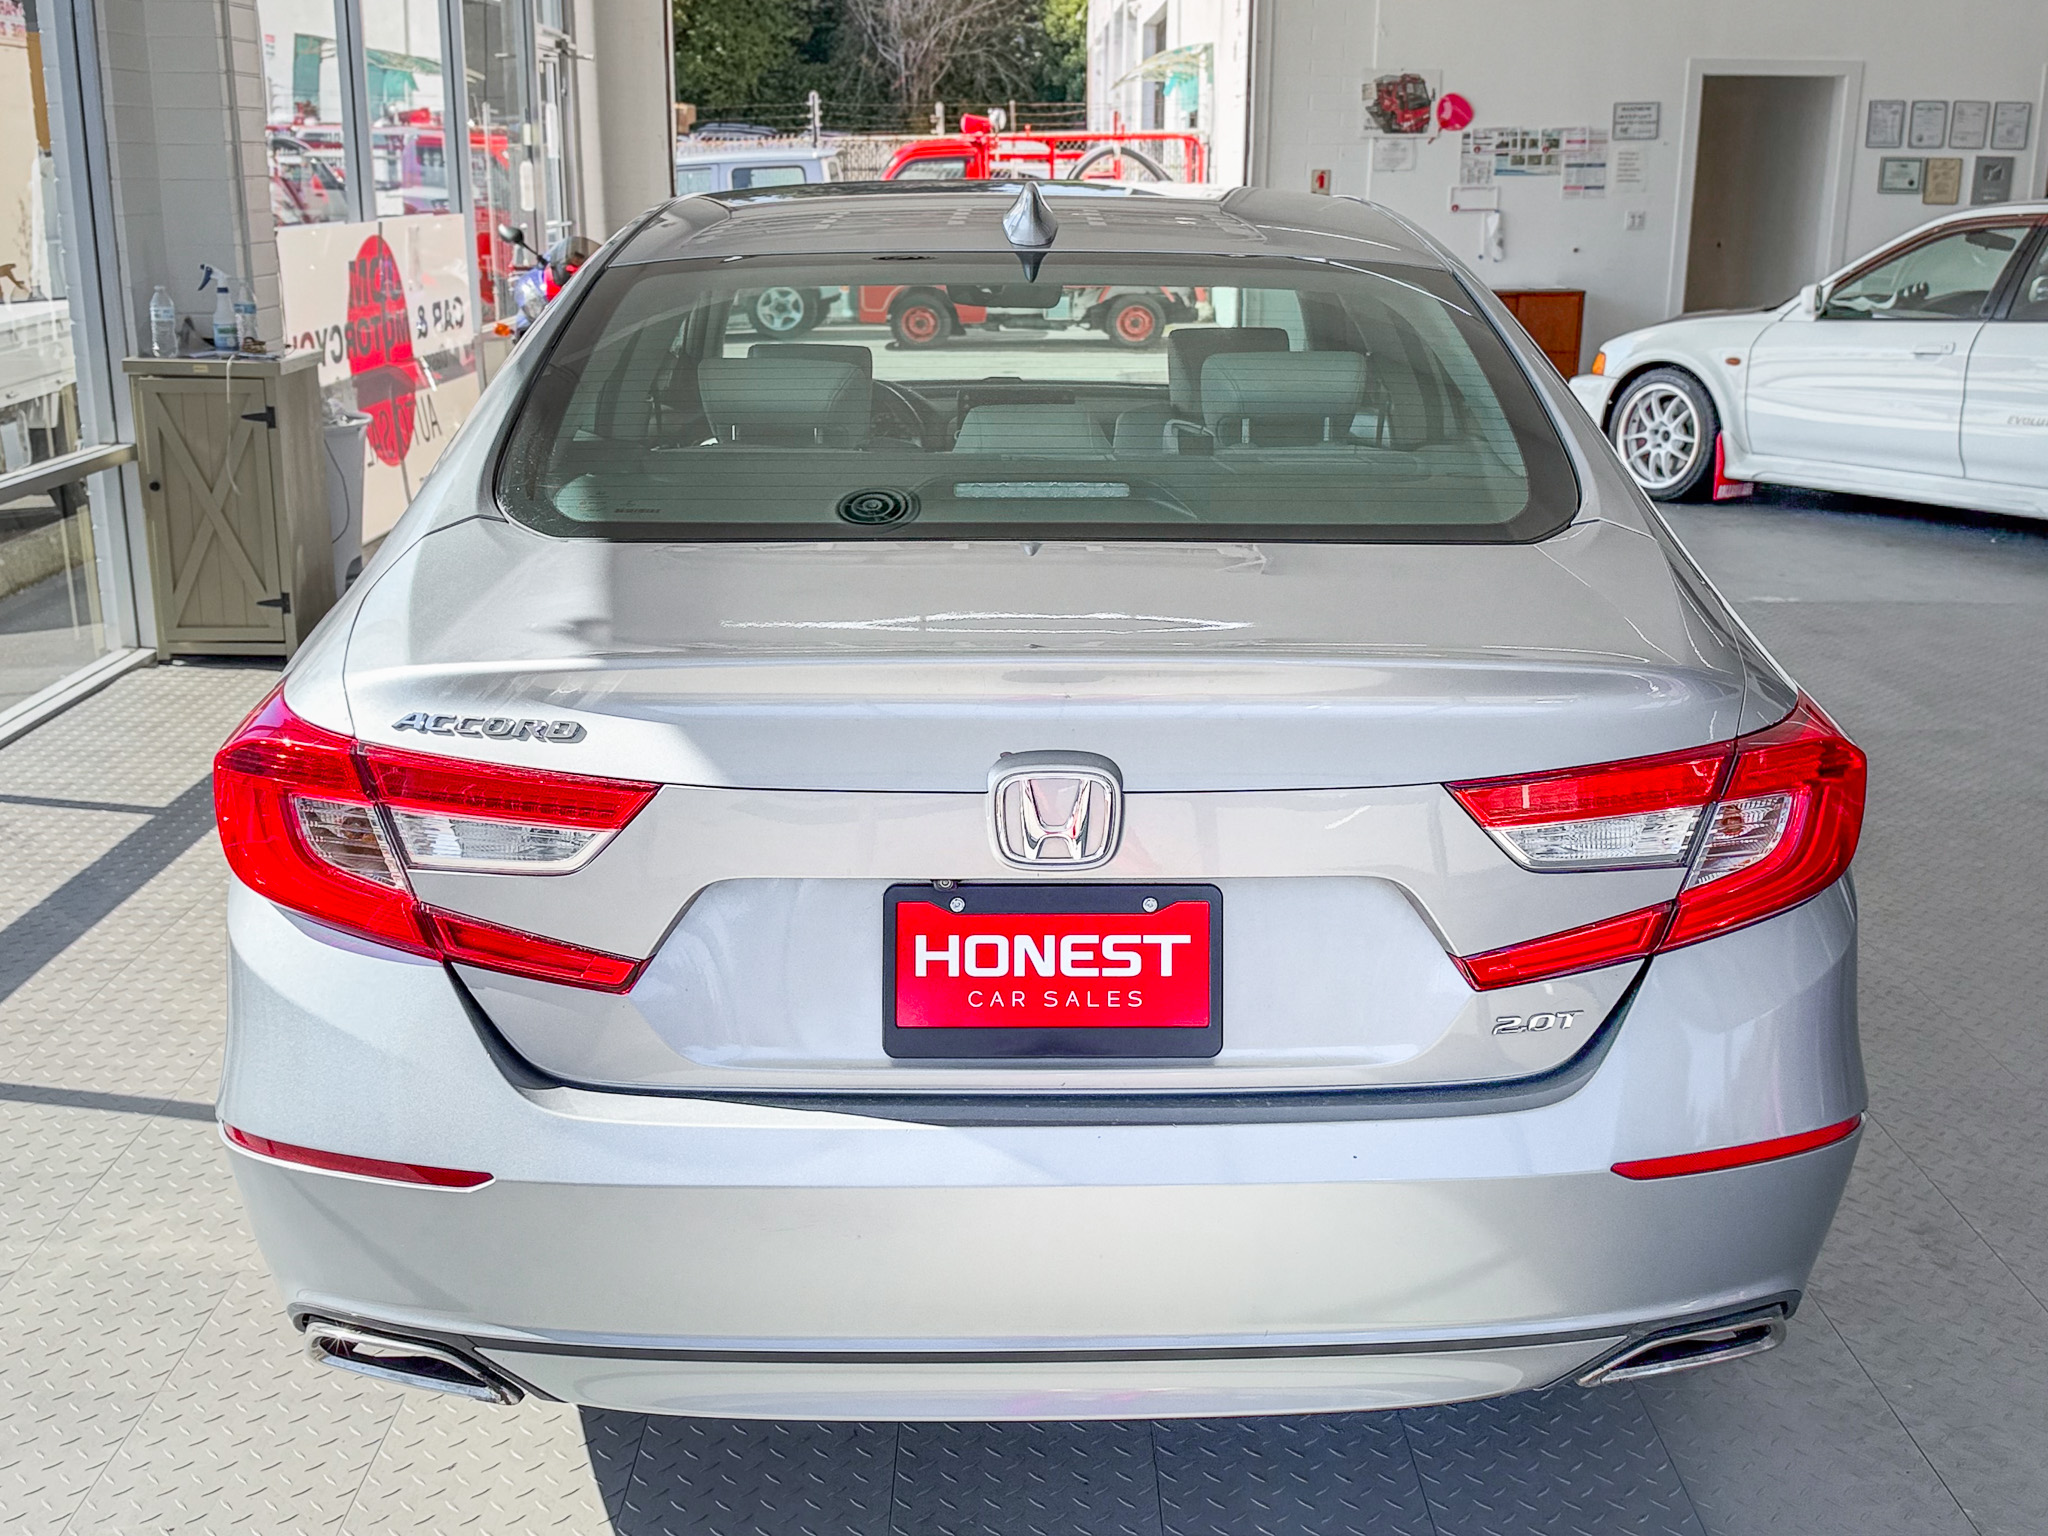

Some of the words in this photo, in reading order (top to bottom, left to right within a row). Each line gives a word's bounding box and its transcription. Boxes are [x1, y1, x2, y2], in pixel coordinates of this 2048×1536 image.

[391, 712, 588, 744] ACCORD
[915, 934, 1192, 978] HONEST
[967, 990, 1026, 1008] CAR
[1043, 990, 1143, 1008] SALES
[1492, 1009, 1584, 1035] 2.0T
